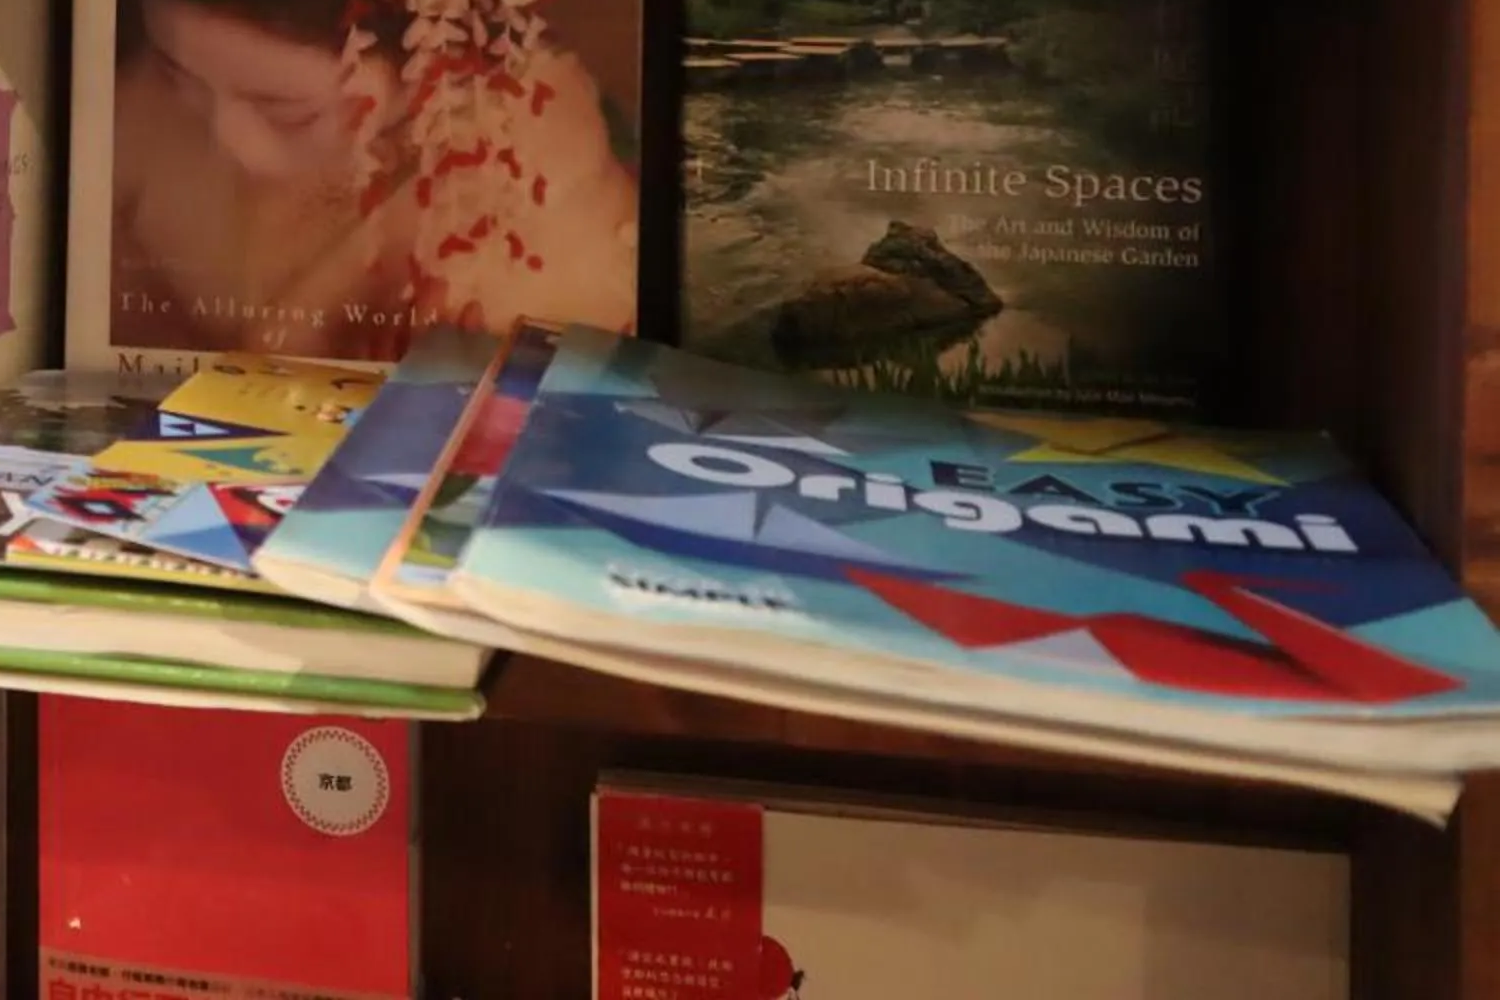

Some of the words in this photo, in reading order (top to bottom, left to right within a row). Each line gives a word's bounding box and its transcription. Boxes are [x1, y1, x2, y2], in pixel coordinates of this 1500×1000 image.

[865, 158, 1028, 197] Infinite
[1044, 163, 1203, 207] Spaces
[996, 216, 1027, 237] Art
[1031, 216, 1074, 239] and
[1080, 216, 1171, 242] Wisdom
[1177, 218, 1202, 242] of
[1017, 242, 1115, 268] Japanese
[1120, 244, 1200, 269] Garden
[120, 292, 173, 317] The
[193, 295, 326, 330] Alluring
[342, 301, 439, 330] World
[646, 441, 1359, 553] Origami
[929, 459, 1282, 518] EASY
[317, 772, 353, 792] 京都
